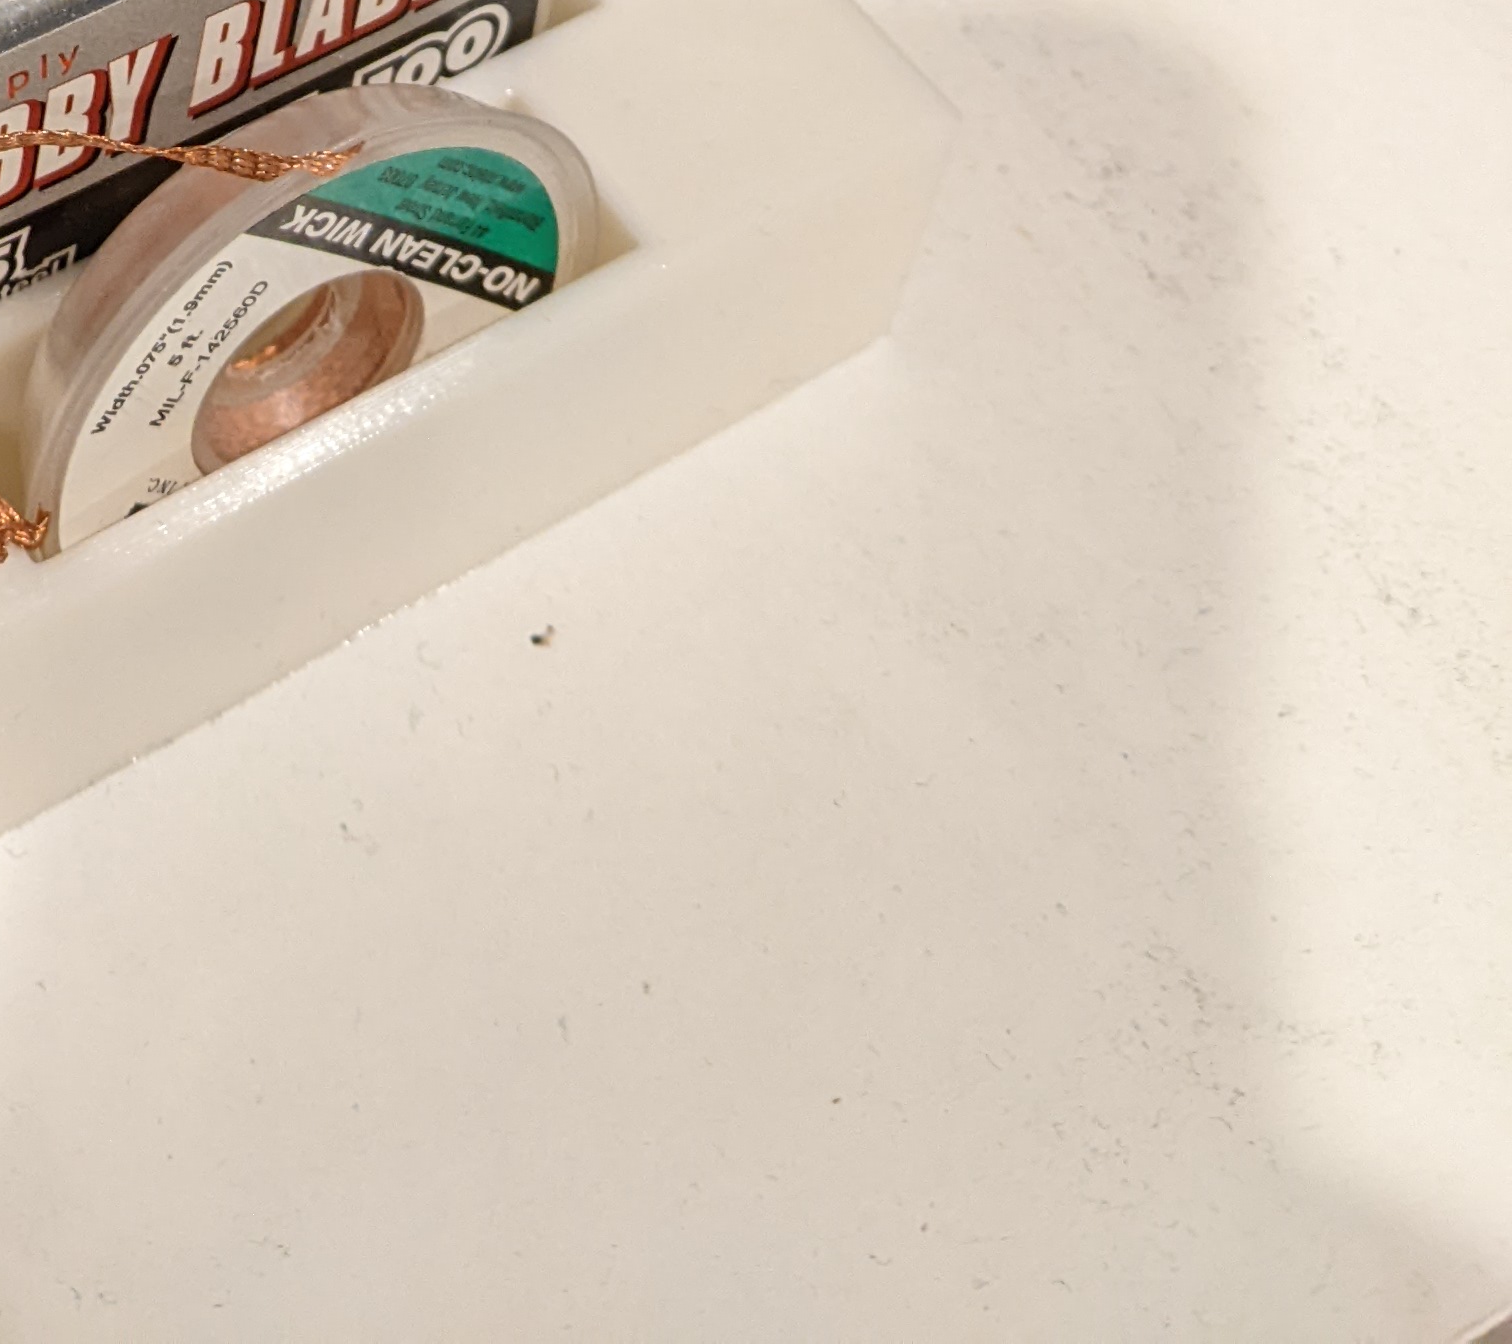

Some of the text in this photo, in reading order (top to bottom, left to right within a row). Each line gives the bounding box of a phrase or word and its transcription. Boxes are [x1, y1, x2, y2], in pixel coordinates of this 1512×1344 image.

[278, 203, 374, 249] WICK
[369, 227, 540, 303] NO-CLEAN
[168, 354, 184, 368] 5
